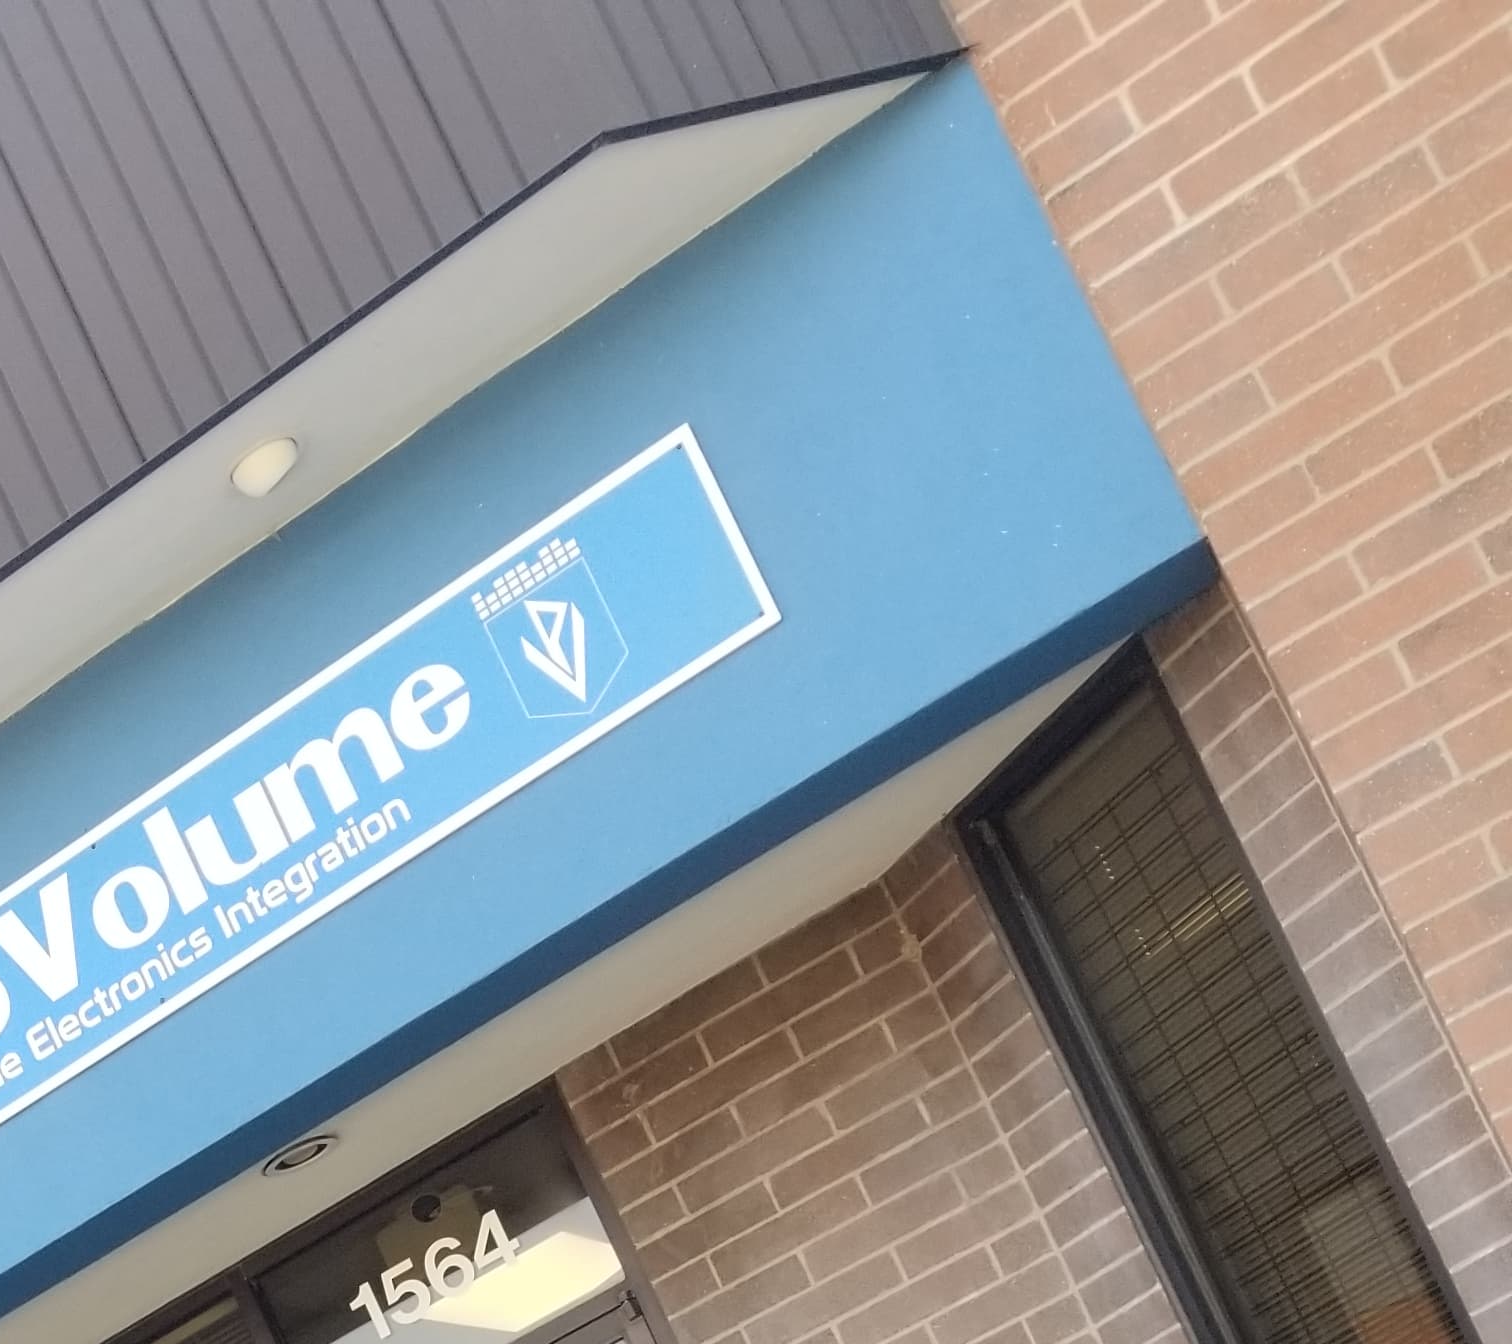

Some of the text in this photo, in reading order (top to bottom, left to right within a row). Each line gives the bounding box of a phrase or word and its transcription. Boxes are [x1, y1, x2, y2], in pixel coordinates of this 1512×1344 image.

[25, 928, 214, 1062] Electronics
[214, 798, 412, 939] Integration
[348, 1208, 521, 1340] 1564
